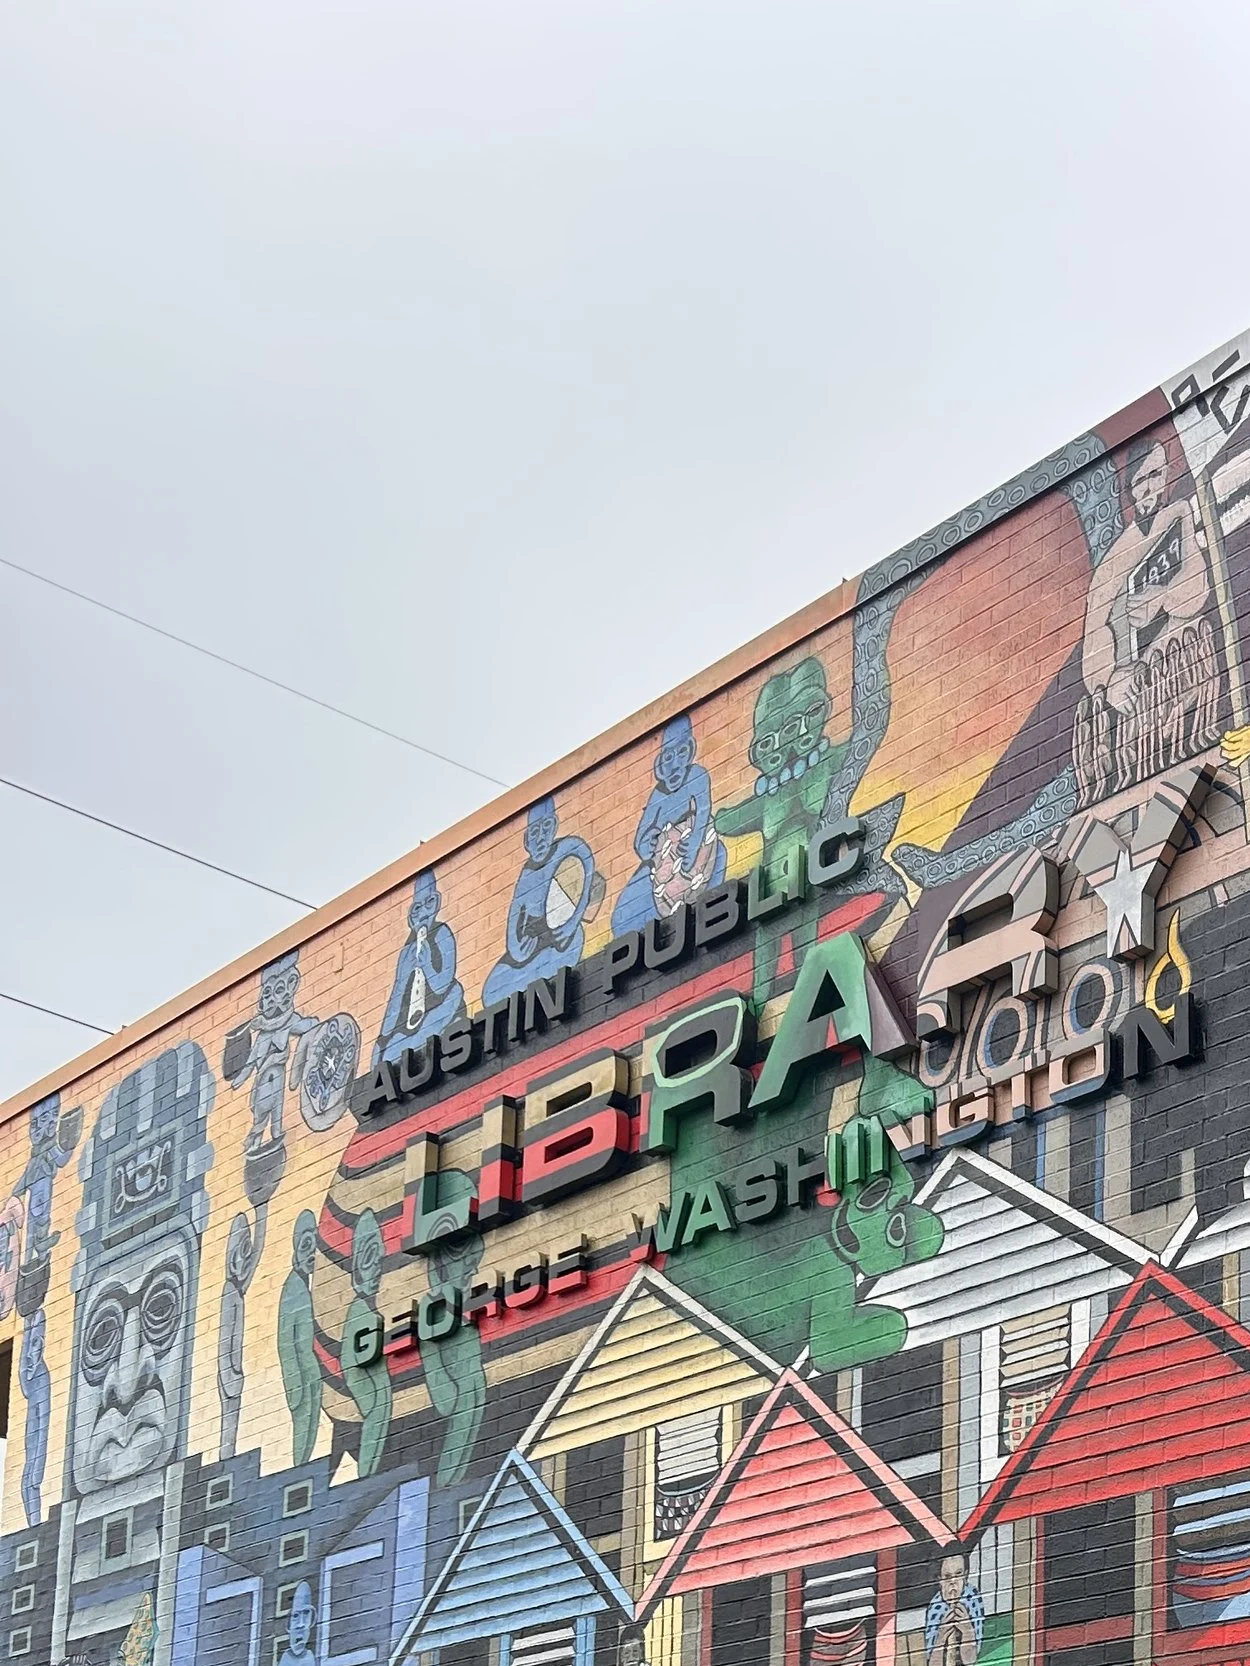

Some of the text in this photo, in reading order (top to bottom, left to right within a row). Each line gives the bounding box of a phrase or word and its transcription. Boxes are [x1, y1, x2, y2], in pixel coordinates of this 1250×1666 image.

[361, 816, 865, 1116] AUSTIN PUBLIC
[402, 762, 1218, 1255] LIBRARY
[345, 1234, 587, 1367] GEORGE
[630, 991, 1195, 1263] WASHINGTON
